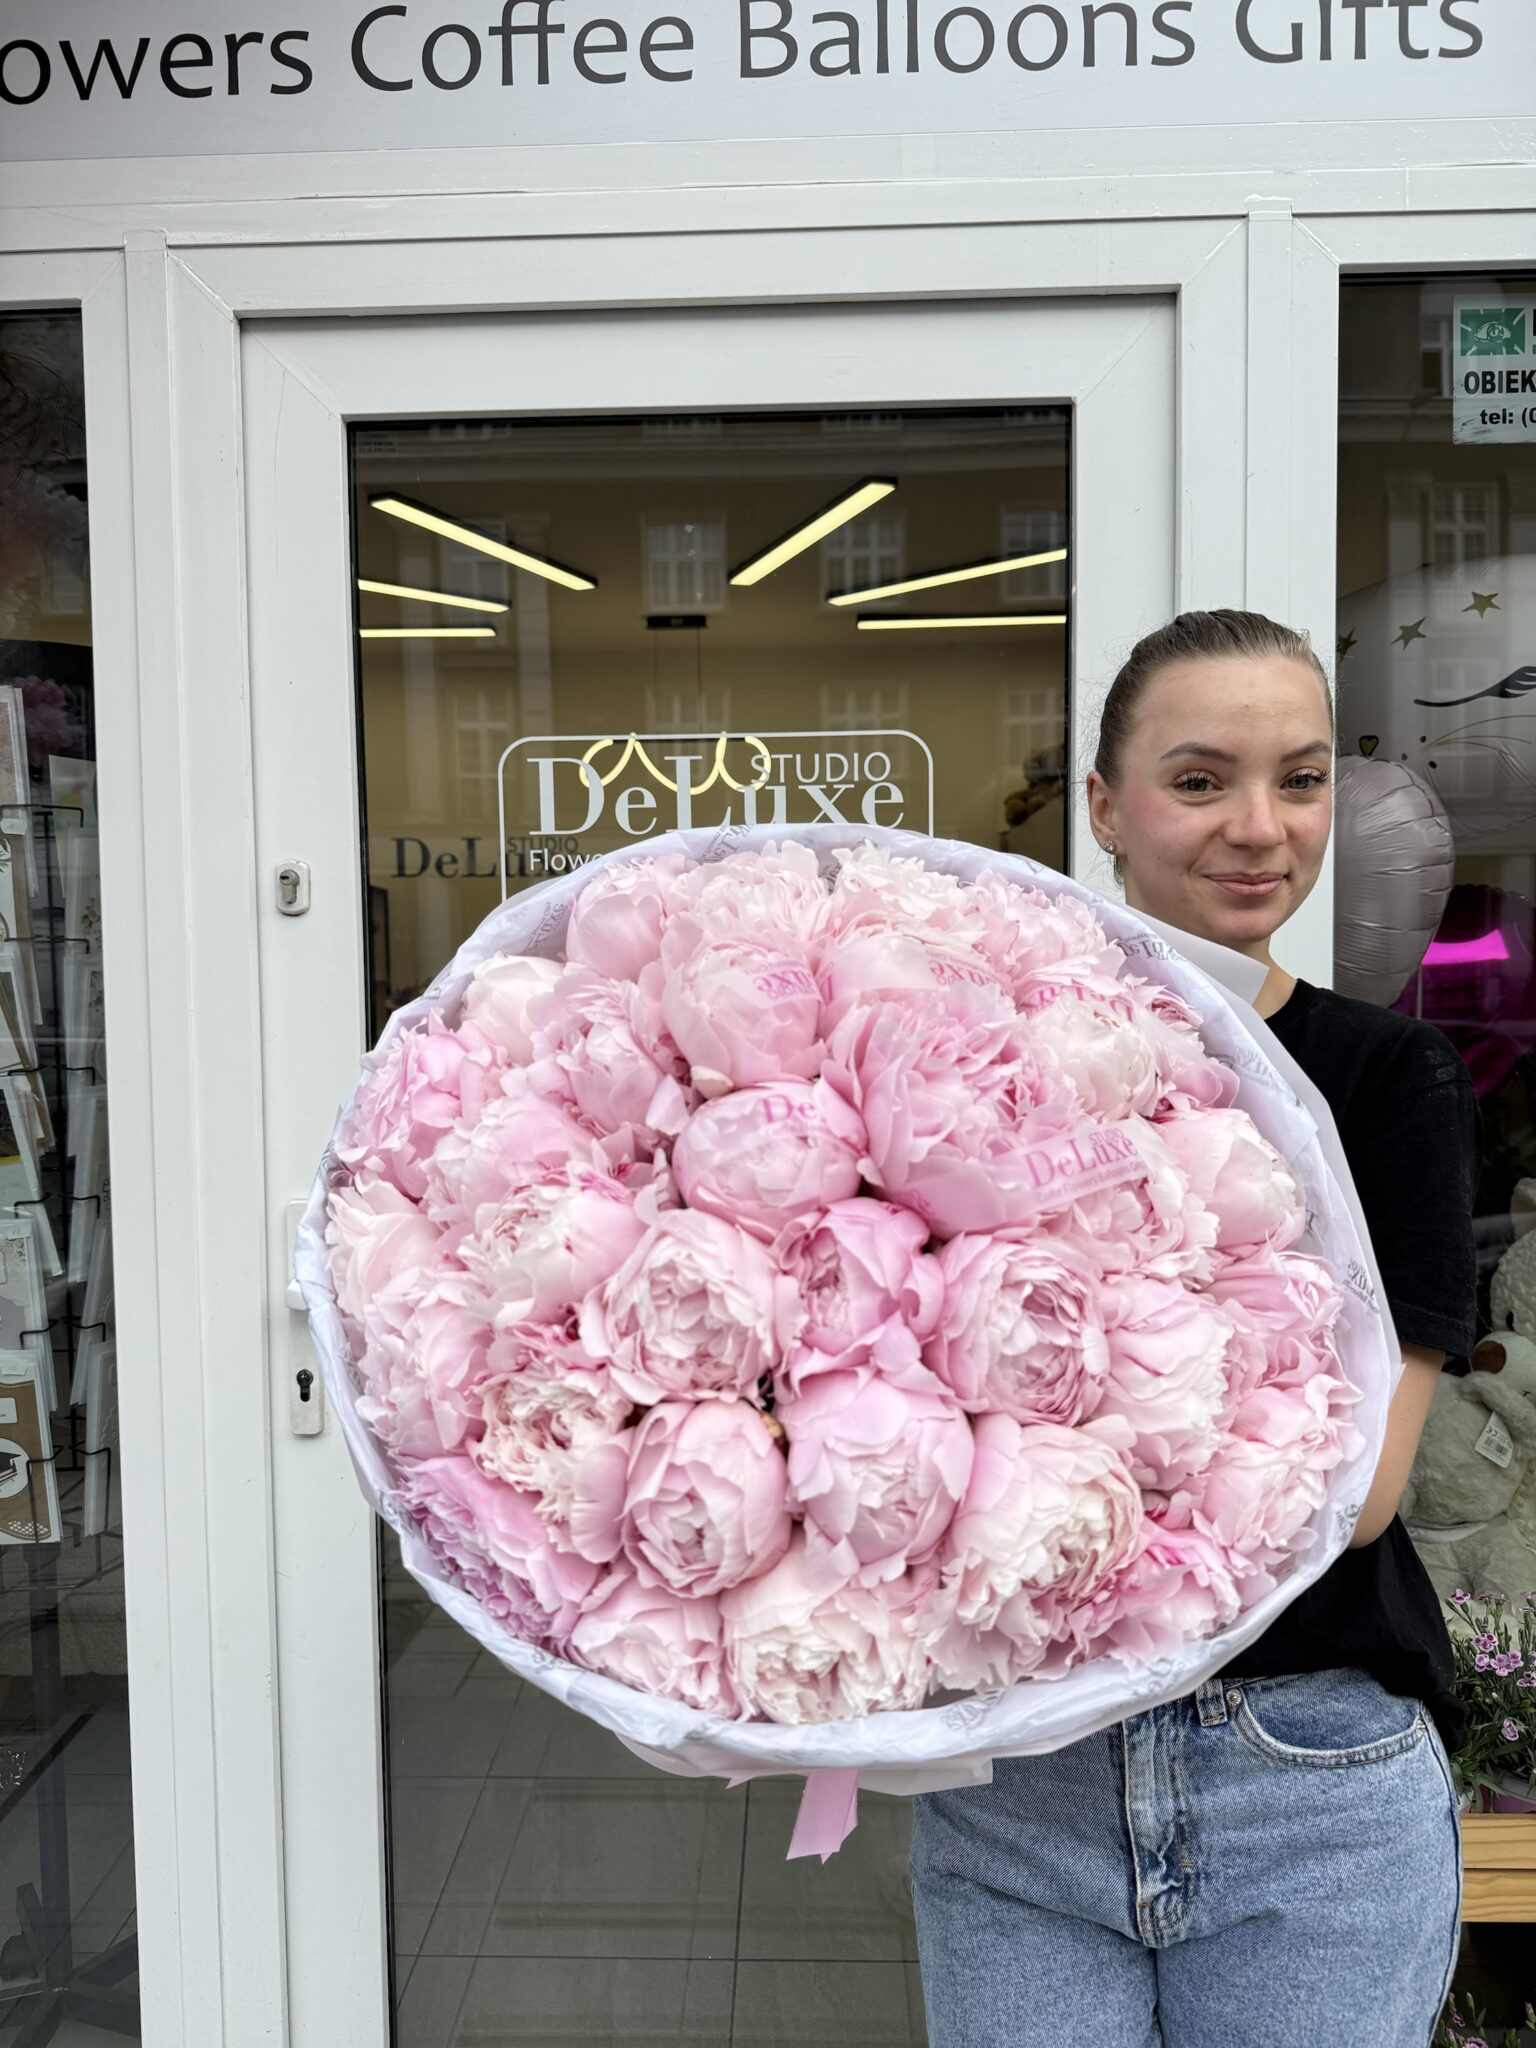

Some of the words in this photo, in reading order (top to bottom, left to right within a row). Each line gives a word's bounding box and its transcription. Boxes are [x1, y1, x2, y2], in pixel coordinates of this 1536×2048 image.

[0, 29, 313, 105] owers
[350, 0, 695, 92] Coffee
[739, 0, 1196, 79] Balloons
[1235, 0, 1484, 64] Gifts
[1463, 369, 1536, 395] OBIEK
[1479, 408, 1514, 425] tel:
[750, 751, 892, 785] STUDIO
[526, 755, 905, 836] DeLuxe
[506, 836, 579, 852] STUDIO
[1023, 1138, 1138, 1187] DeLuxe
